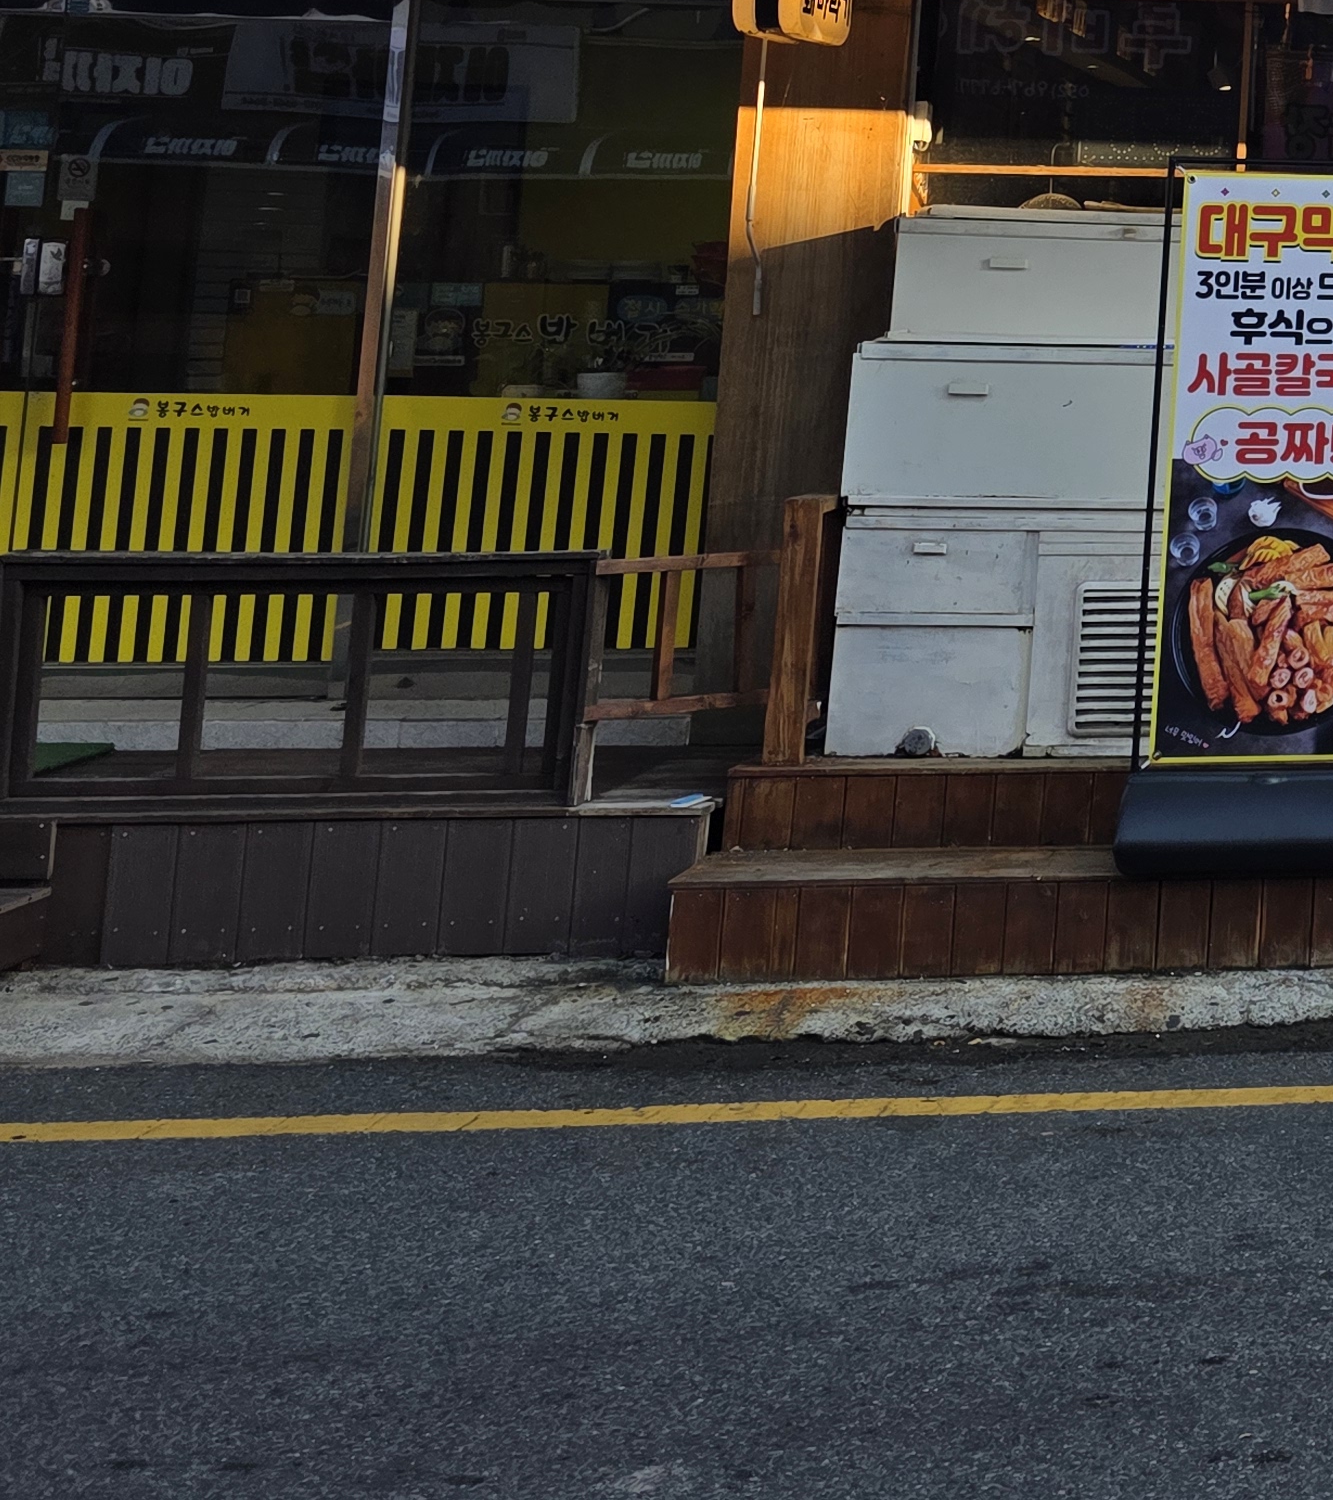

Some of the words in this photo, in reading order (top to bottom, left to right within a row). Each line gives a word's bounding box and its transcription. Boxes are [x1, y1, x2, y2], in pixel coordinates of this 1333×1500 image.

[1195, 270, 1266, 301] 3인분
[1271, 276, 1314, 300] 이상
[471, 318, 534, 348] 봉구스
